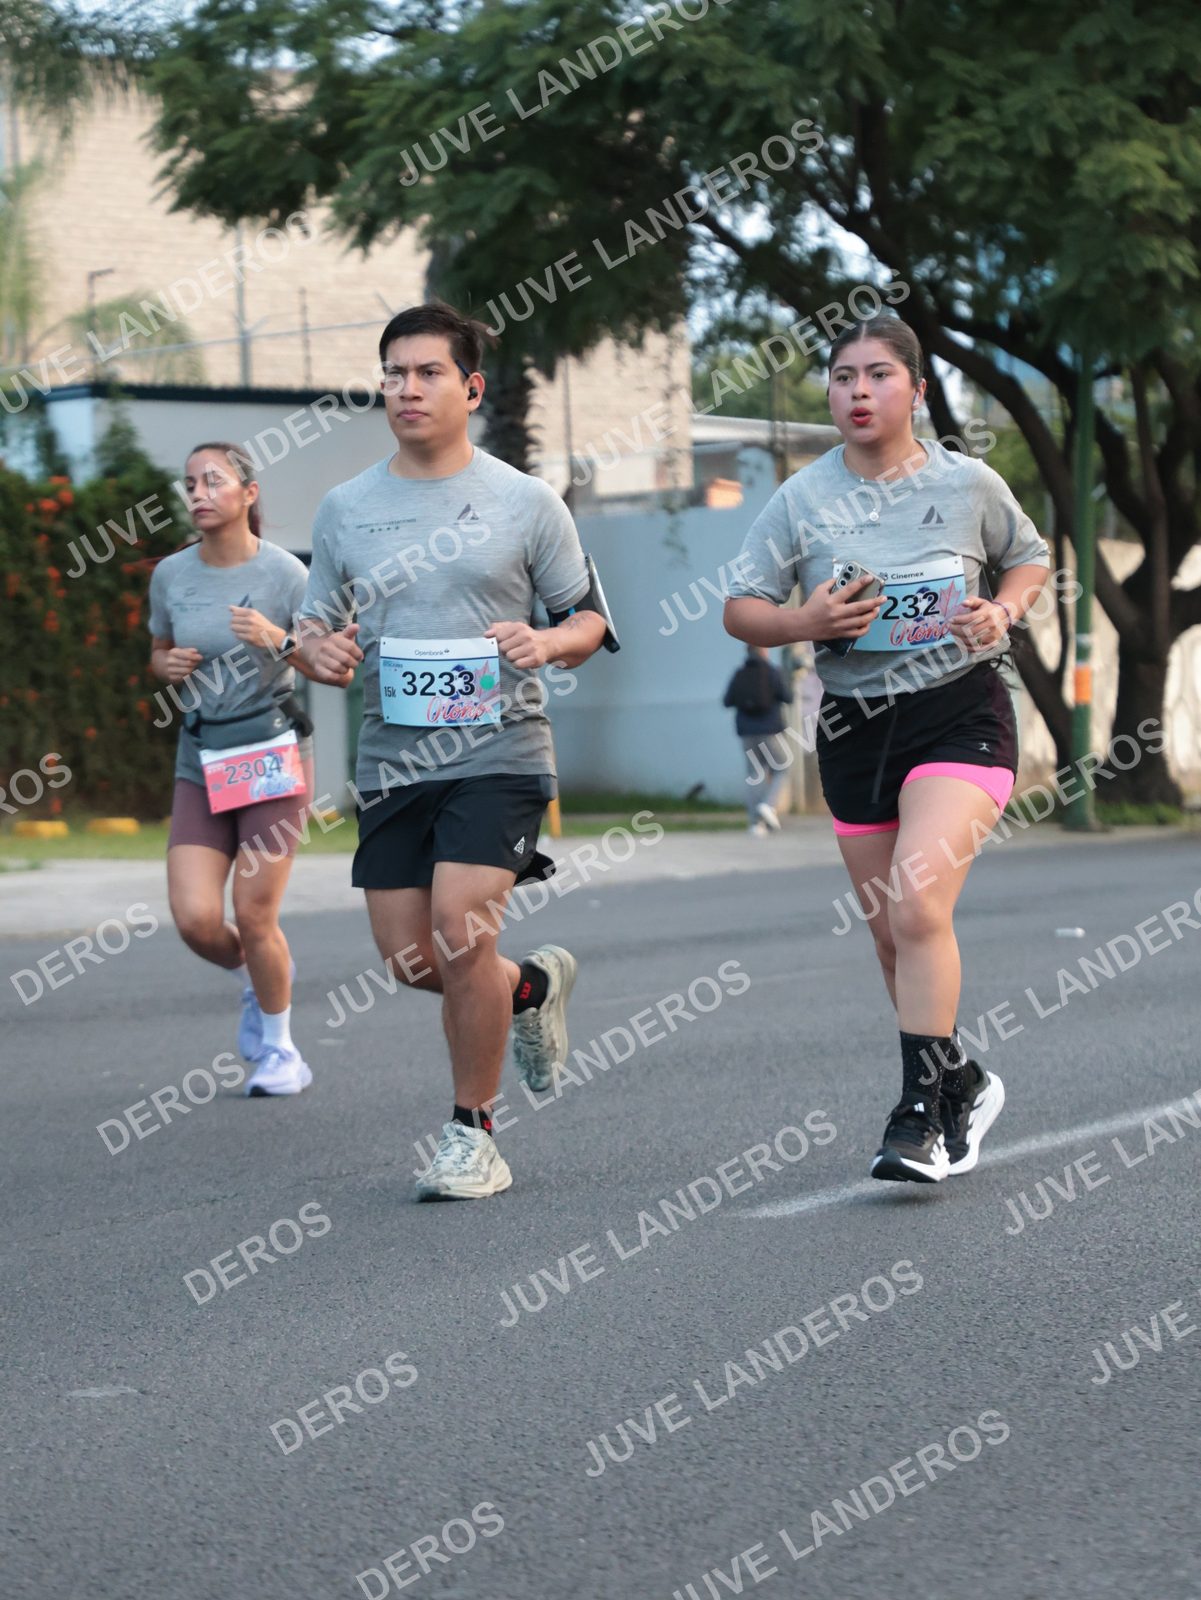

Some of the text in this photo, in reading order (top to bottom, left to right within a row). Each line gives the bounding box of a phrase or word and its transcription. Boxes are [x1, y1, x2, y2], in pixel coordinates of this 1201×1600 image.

[891, 571, 925, 580] Cinemex
[881, 591, 940, 620] 232
[401, 671, 476, 696] 3233
[225, 757, 282, 785] 2304
